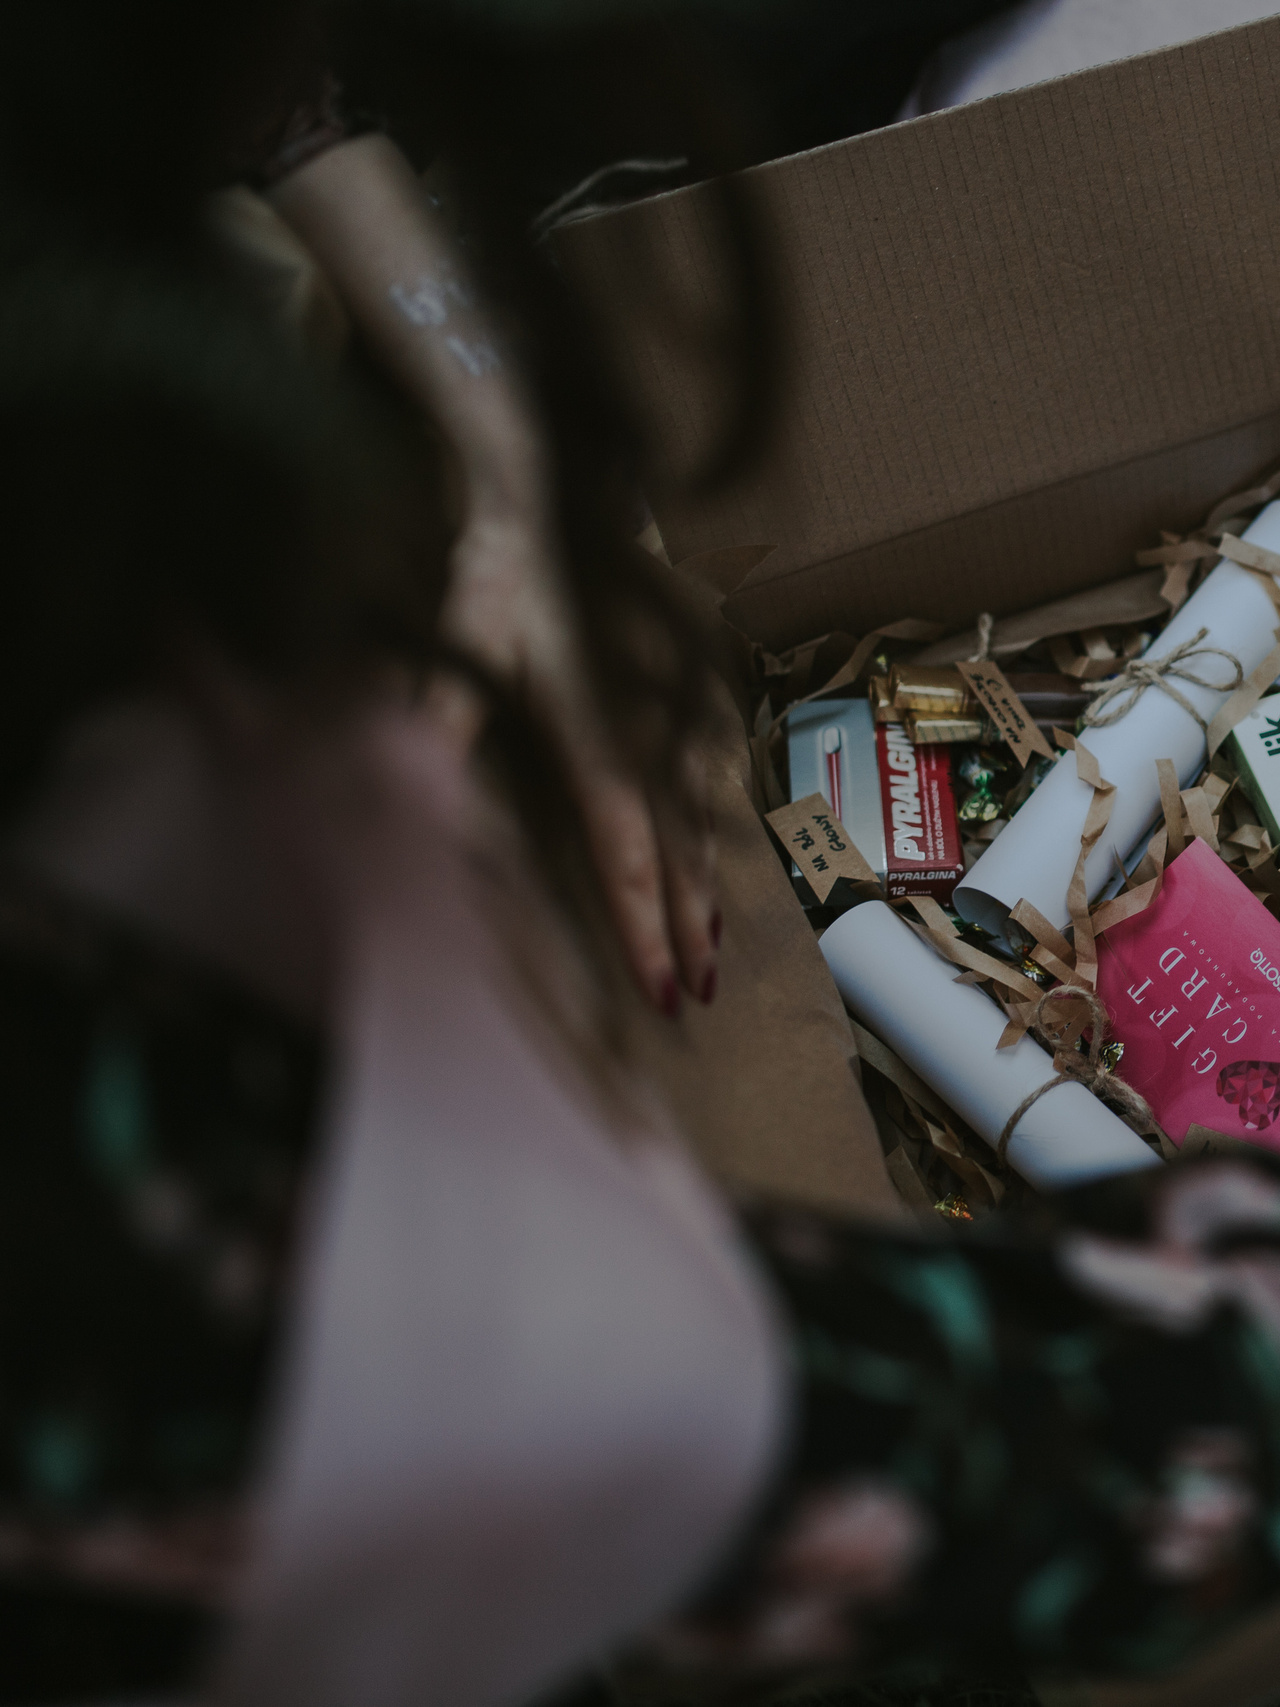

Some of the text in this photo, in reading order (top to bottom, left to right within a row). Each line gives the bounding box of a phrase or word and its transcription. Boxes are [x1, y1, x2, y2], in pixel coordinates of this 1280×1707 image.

[885, 724, 925, 861] PYRALGIN
[792, 827, 829, 872] NA BÓL
[889, 870, 956, 881] PYRALGINA
[890, 886, 906, 895] 12
[1158, 947, 1248, 1044] CARD
[1183, 930, 1263, 1019] PODARUNKOWA
[1126, 976, 1217, 1074] GIFT
